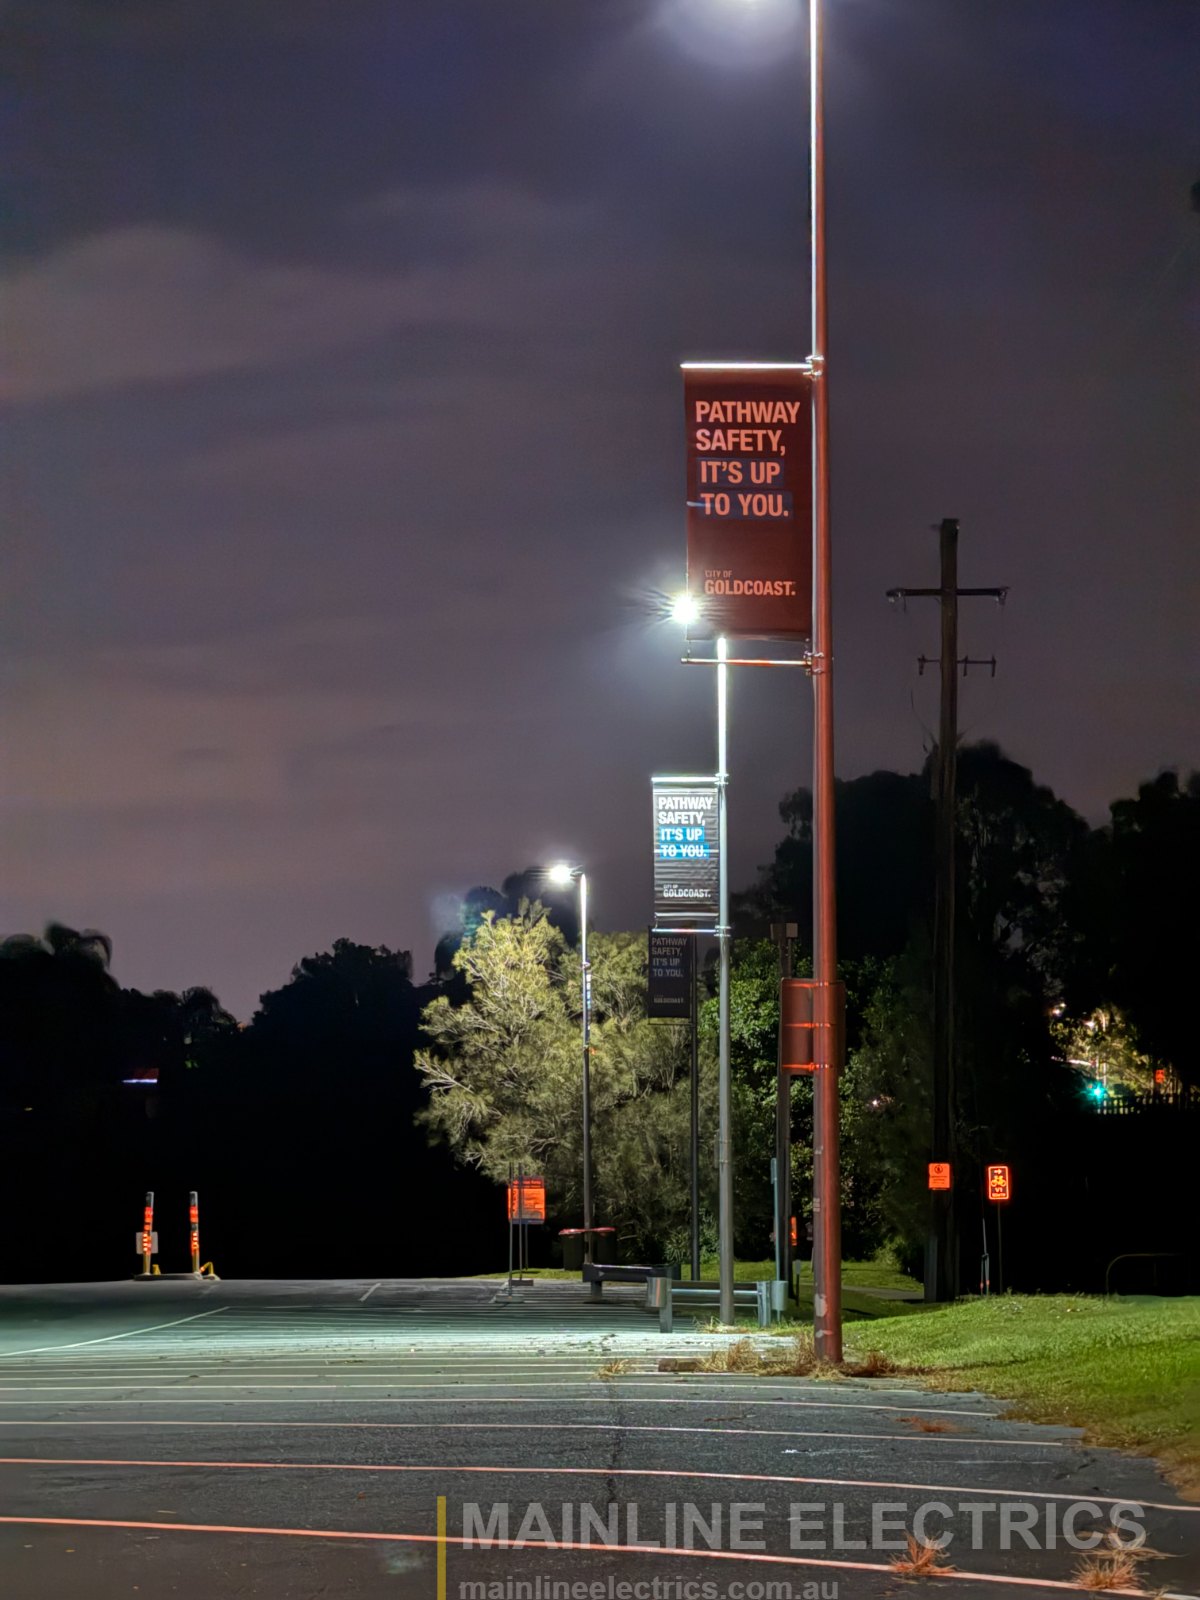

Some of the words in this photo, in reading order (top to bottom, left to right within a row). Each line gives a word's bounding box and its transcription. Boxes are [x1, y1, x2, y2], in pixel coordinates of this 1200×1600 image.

[695, 401, 800, 424] PATHWAY
[695, 429, 786, 456] SAFETY,
[701, 461, 743, 484] IT'S
[750, 461, 780, 484] UP
[700, 493, 730, 515] TO
[738, 493, 789, 517] YOU.
[705, 579, 796, 596] GOLDCOAST.
[658, 797, 713, 810] PATHWAY
[658, 812, 705, 826] SAFETY,
[661, 829, 683, 841] IT'S
[686, 829, 702, 841] UP
[661, 845, 677, 857] TO
[679, 845, 707, 857] YOU.
[652, 938, 687, 946] PATHWAY
[652, 947, 682, 956] SAFETY,
[669, 958, 680, 966] UP
[653, 969, 663, 977] TO
